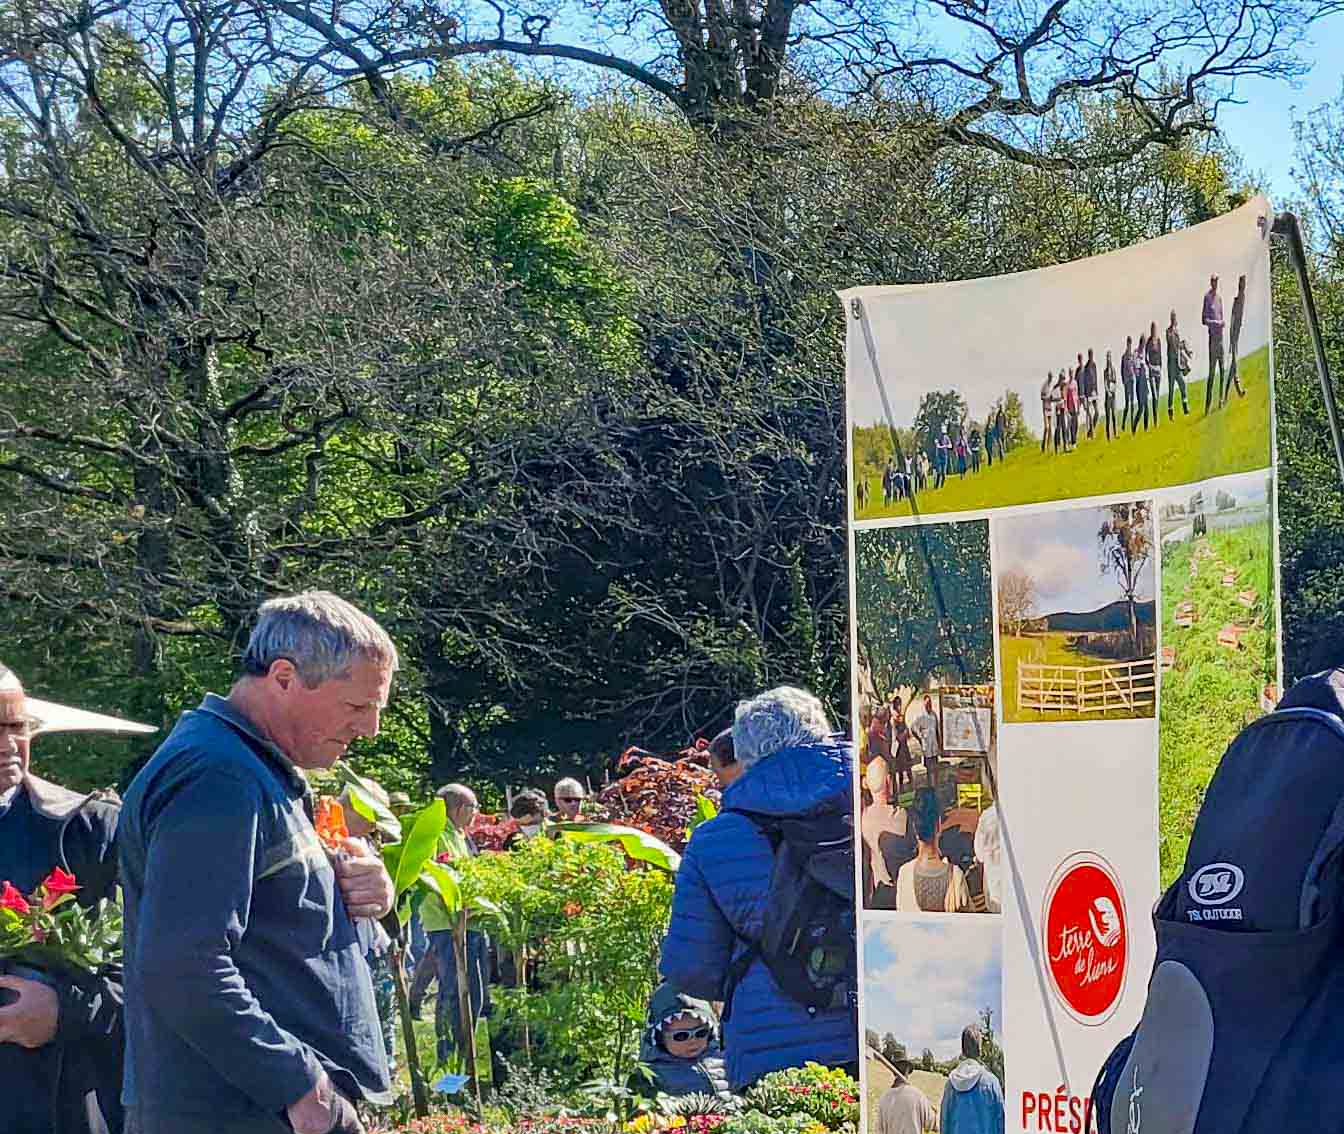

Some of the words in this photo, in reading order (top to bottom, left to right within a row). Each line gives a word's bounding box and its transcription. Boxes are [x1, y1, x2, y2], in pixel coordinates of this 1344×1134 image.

[1051, 924, 1093, 961] terre
[1073, 951, 1087, 976] de
[1079, 945, 1119, 987] liens
